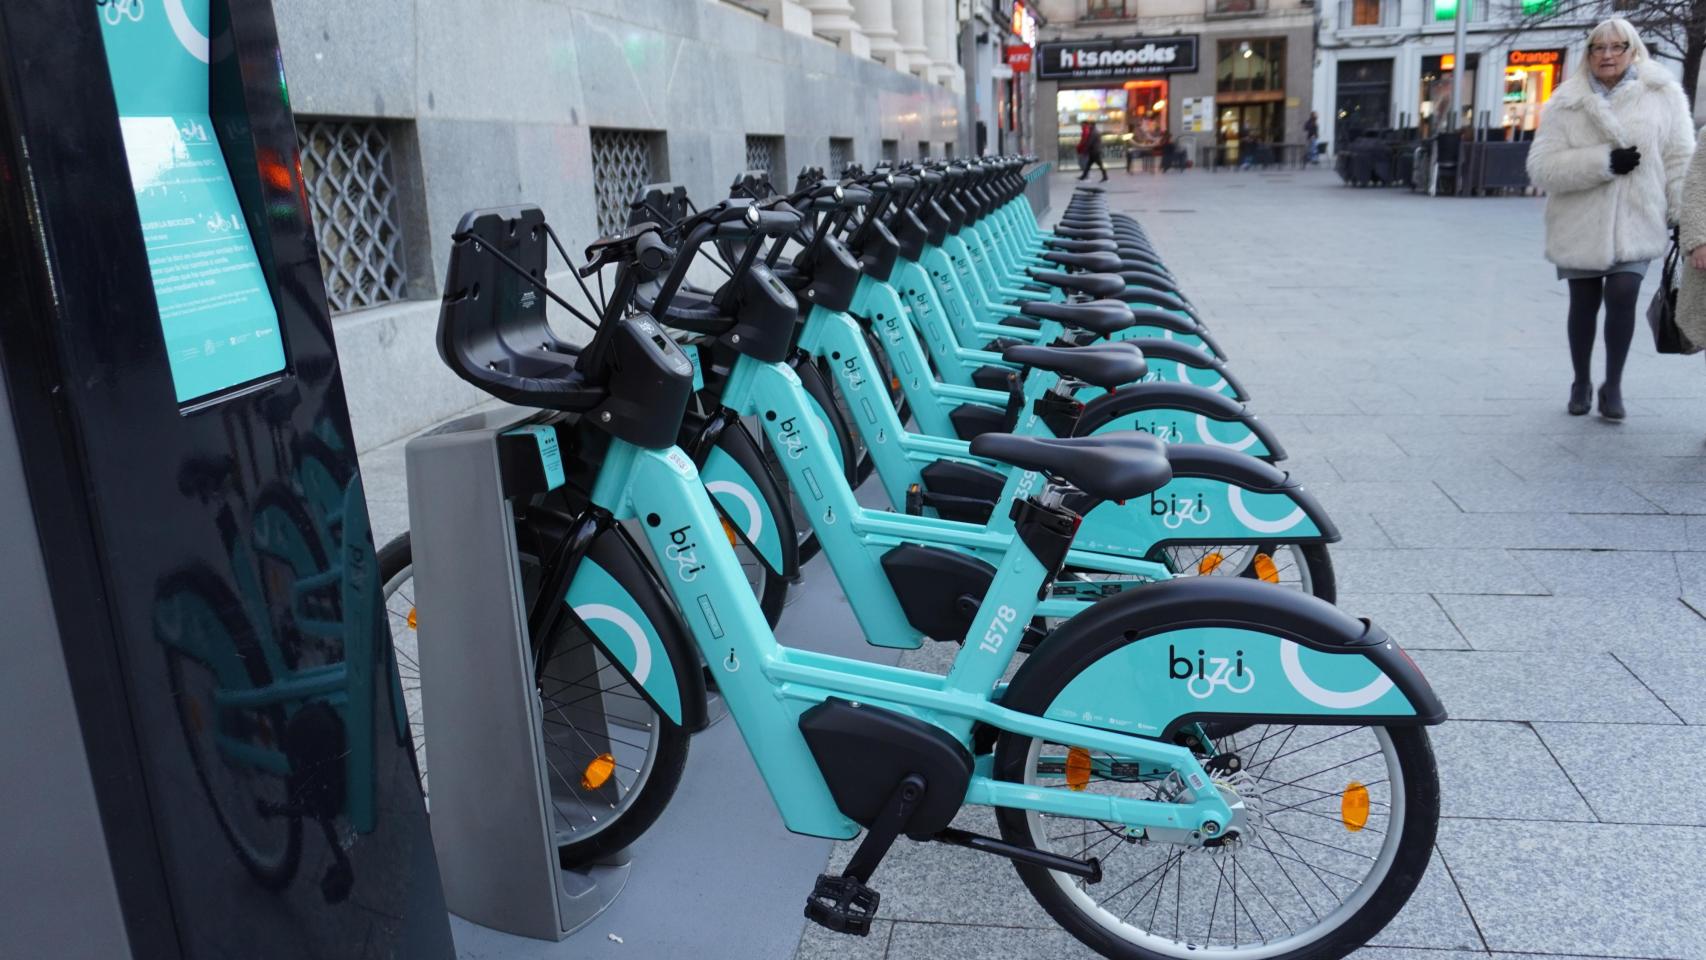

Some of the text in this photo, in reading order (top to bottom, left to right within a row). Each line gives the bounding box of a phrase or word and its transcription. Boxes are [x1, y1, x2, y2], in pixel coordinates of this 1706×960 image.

[1009, 53, 1029, 62] KFC
[1510, 50, 1558, 63] Orange
[843, 356, 867, 390] bizi
[779, 417, 808, 460] bizi
[1151, 491, 1211, 529] bizi
[666, 525, 706, 583] bizi
[979, 604, 1017, 656] 1578
[1168, 644, 1256, 699] bizi
